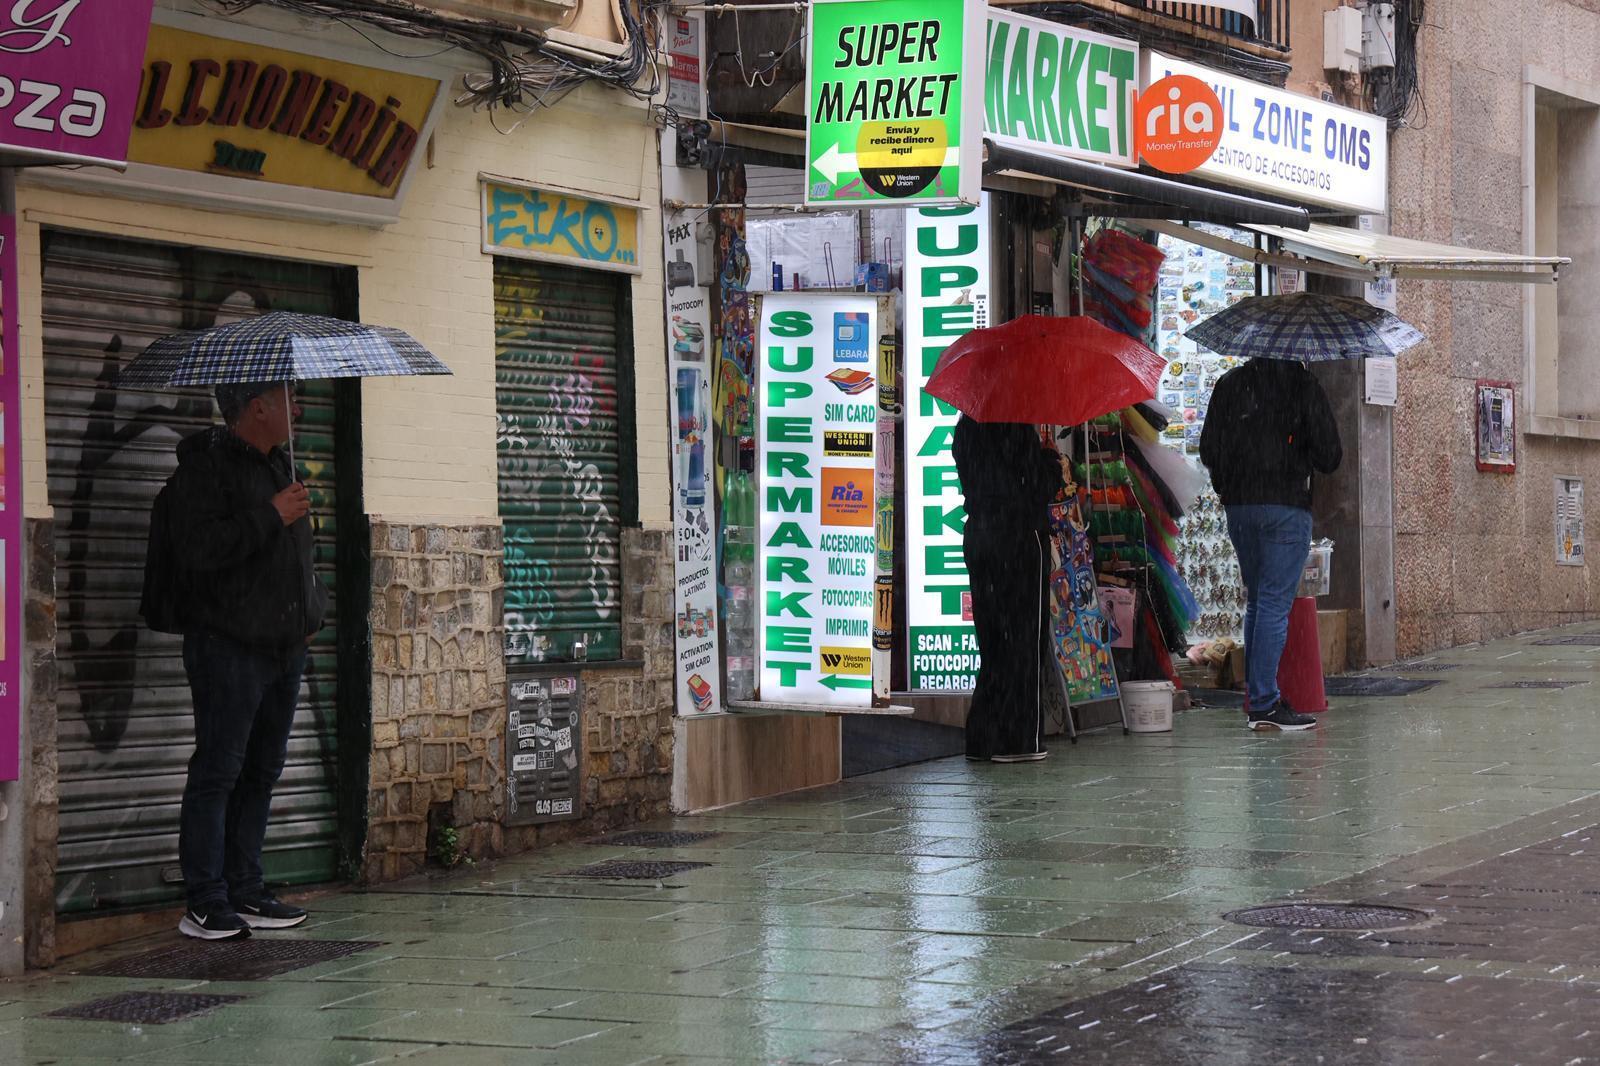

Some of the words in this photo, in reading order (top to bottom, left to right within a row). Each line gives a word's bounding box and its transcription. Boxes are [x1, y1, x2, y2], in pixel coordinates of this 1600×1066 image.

[834, 20, 940, 68] SUPER
[815, 73, 958, 124] MARKET
[1146, 86, 1213, 136] ria
[135, 58, 418, 188] LCHONERÍA
[914, 127, 920, 135] y
[870, 136, 902, 145] recibe
[903, 135, 935, 144] dinero
[1252, 97, 1313, 153] ZONE
[1324, 117, 1371, 171] OMS
[1147, 140, 1177, 152] Money
[1177, 139, 1213, 151] Transfer
[1212, 147, 1252, 171] CENTRO
[1255, 156, 1269, 175] DE
[1270, 161, 1331, 191] ACCESORIOS
[668, 222, 691, 245] FAX
[671, 299, 704, 313] PHOTOCOPY
[835, 348, 869, 359] LEBARA
[824, 403, 844, 423] SIM
[846, 404, 875, 424] CARD
[825, 432, 865, 440] WESTERN
[766, 310, 815, 687] SUPERMARKET
[831, 481, 864, 501] Ria
[820, 533, 875, 553] ACCESORIOS
[828, 553, 866, 576] MÓVILES
[678, 567, 709, 587] PRODUCTOS
[684, 582, 706, 598] LATINOS
[822, 589, 873, 608] FOTOCOPIAS
[825, 618, 868, 637] IMPRIMIR
[679, 640, 713, 661] ACTIVATION
[918, 634, 952, 651] SCAN
[962, 634, 980, 651] FA
[685, 657, 695, 674] SIM
[695, 655, 711, 670] CARD
[843, 655, 871, 663] Western
[843, 660, 864, 669] Union
